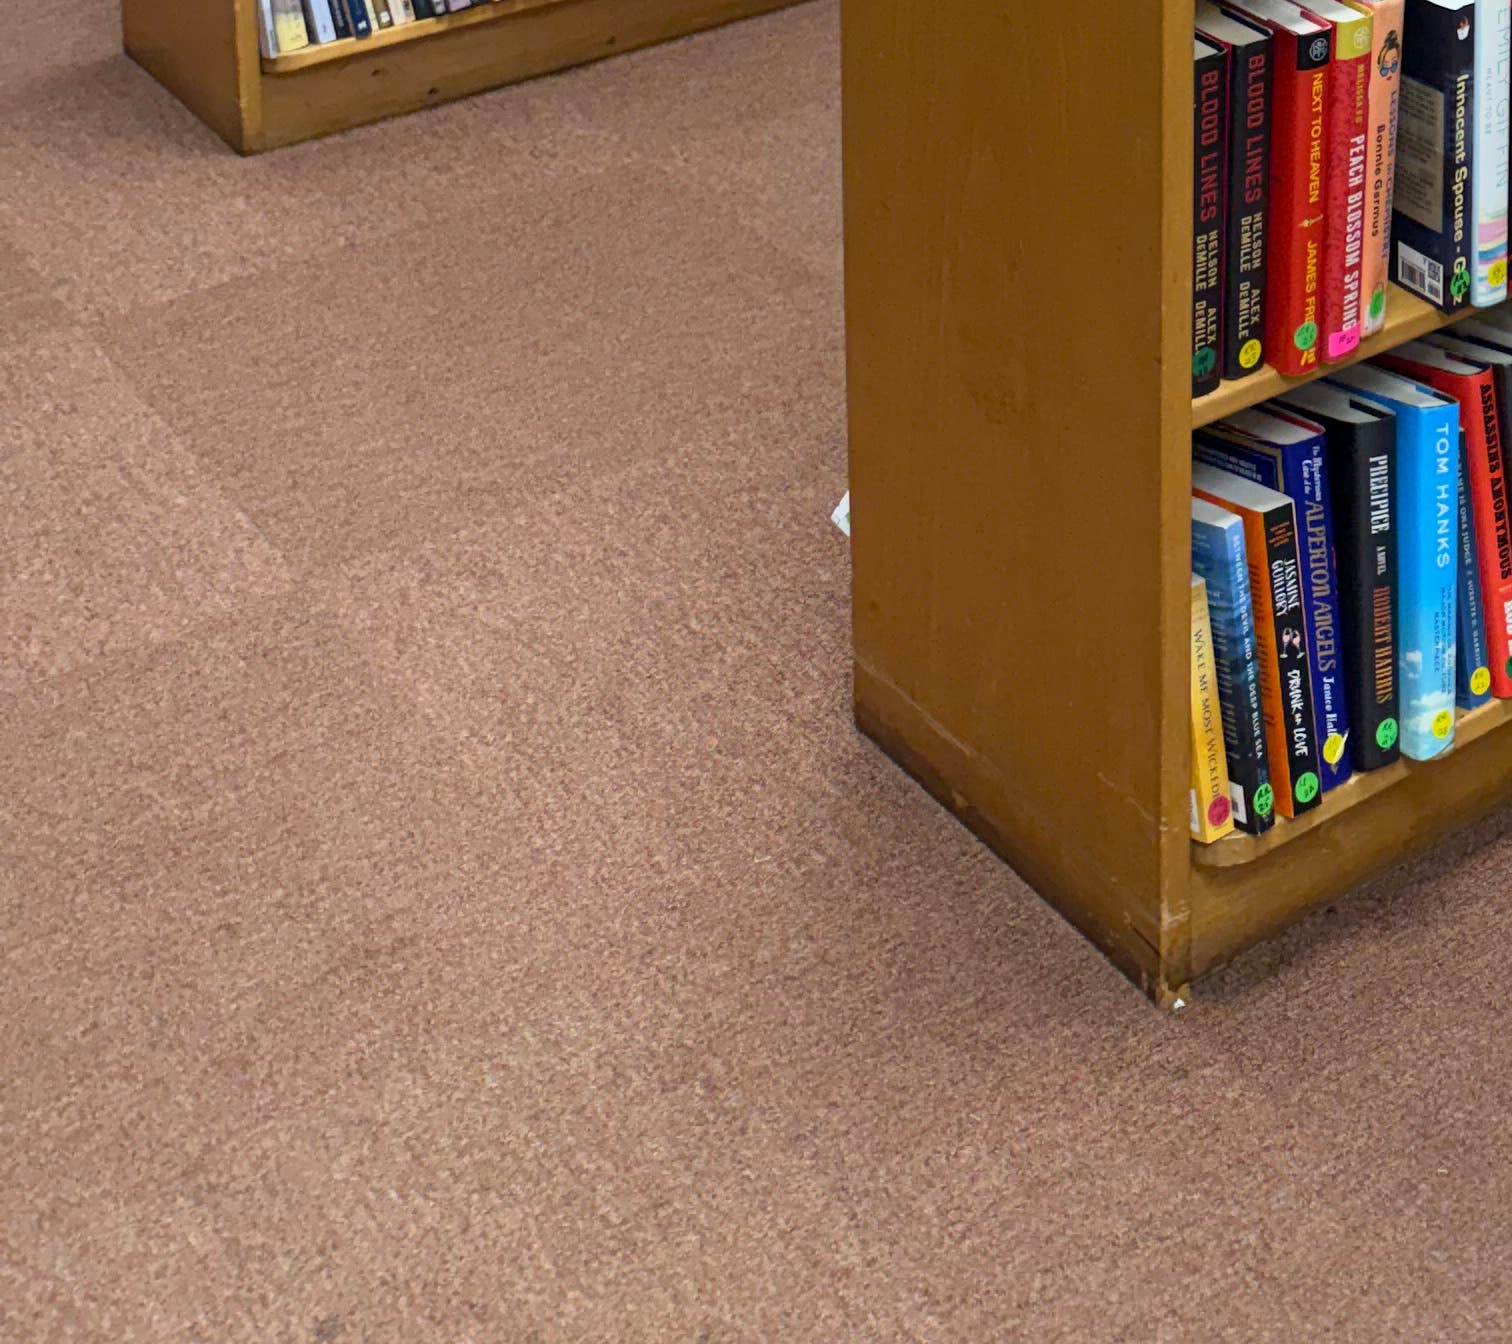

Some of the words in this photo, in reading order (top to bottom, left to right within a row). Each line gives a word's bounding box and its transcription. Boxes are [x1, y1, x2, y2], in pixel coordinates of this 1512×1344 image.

[1201, 69, 1219, 147] BLOOD
[1456, 73, 1469, 161] Innocent
[1200, 152, 1218, 221] LINES
[1348, 135, 1364, 184] PEACH
[1345, 187, 1361, 267] BLOSSOM
[1454, 167, 1468, 243] Spouse
[1343, 269, 1360, 330] SPRING
[1435, 422, 1450, 474] TOM
[1480, 383, 1500, 474] ASSASSINS
[1369, 455, 1390, 535] PRECIPICE
[1436, 485, 1451, 568] HANKS
